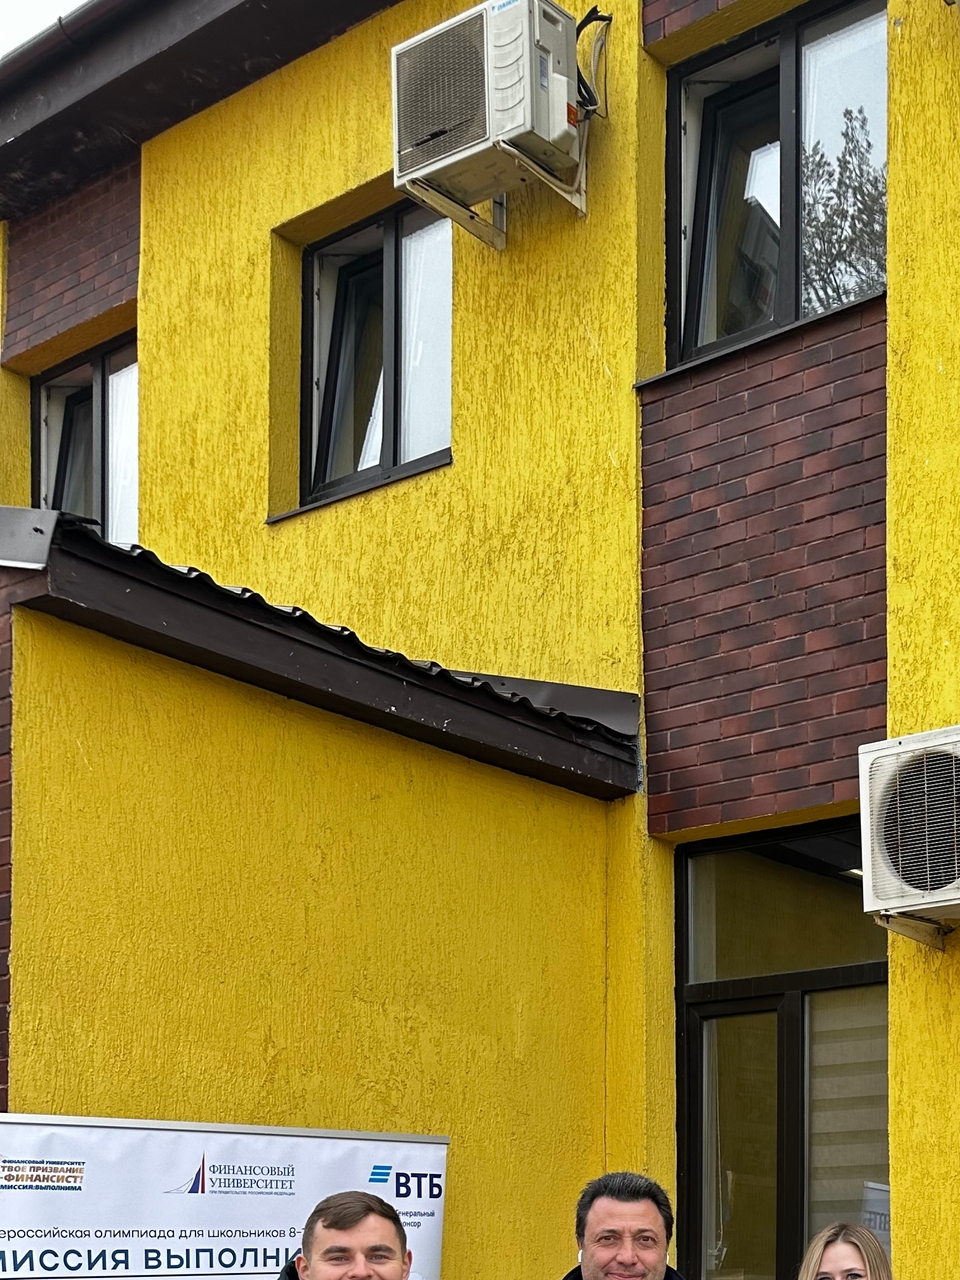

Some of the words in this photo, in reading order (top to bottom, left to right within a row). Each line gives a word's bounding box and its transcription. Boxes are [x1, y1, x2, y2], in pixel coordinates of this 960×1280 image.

[0, 1165, 27, 1173] ТВОЕ
[29, 1165, 85, 1174] ПРИЗВАНИЕ
[208, 1164, 295, 1177] ФИНАНСОВЫЙ
[209, 1178, 295, 1190] УНИВЕРСИТЕТ
[395, 1172, 443, 1199] ВТБ
[0, 1226, 91, 1241] ероссийская
[94, 1229, 175, 1240] олимпиада
[178, 1229, 204, 1240] для
[207, 1229, 286, 1238] школьников
[144, 1247, 302, 1270] ВЫПОЛНИ
